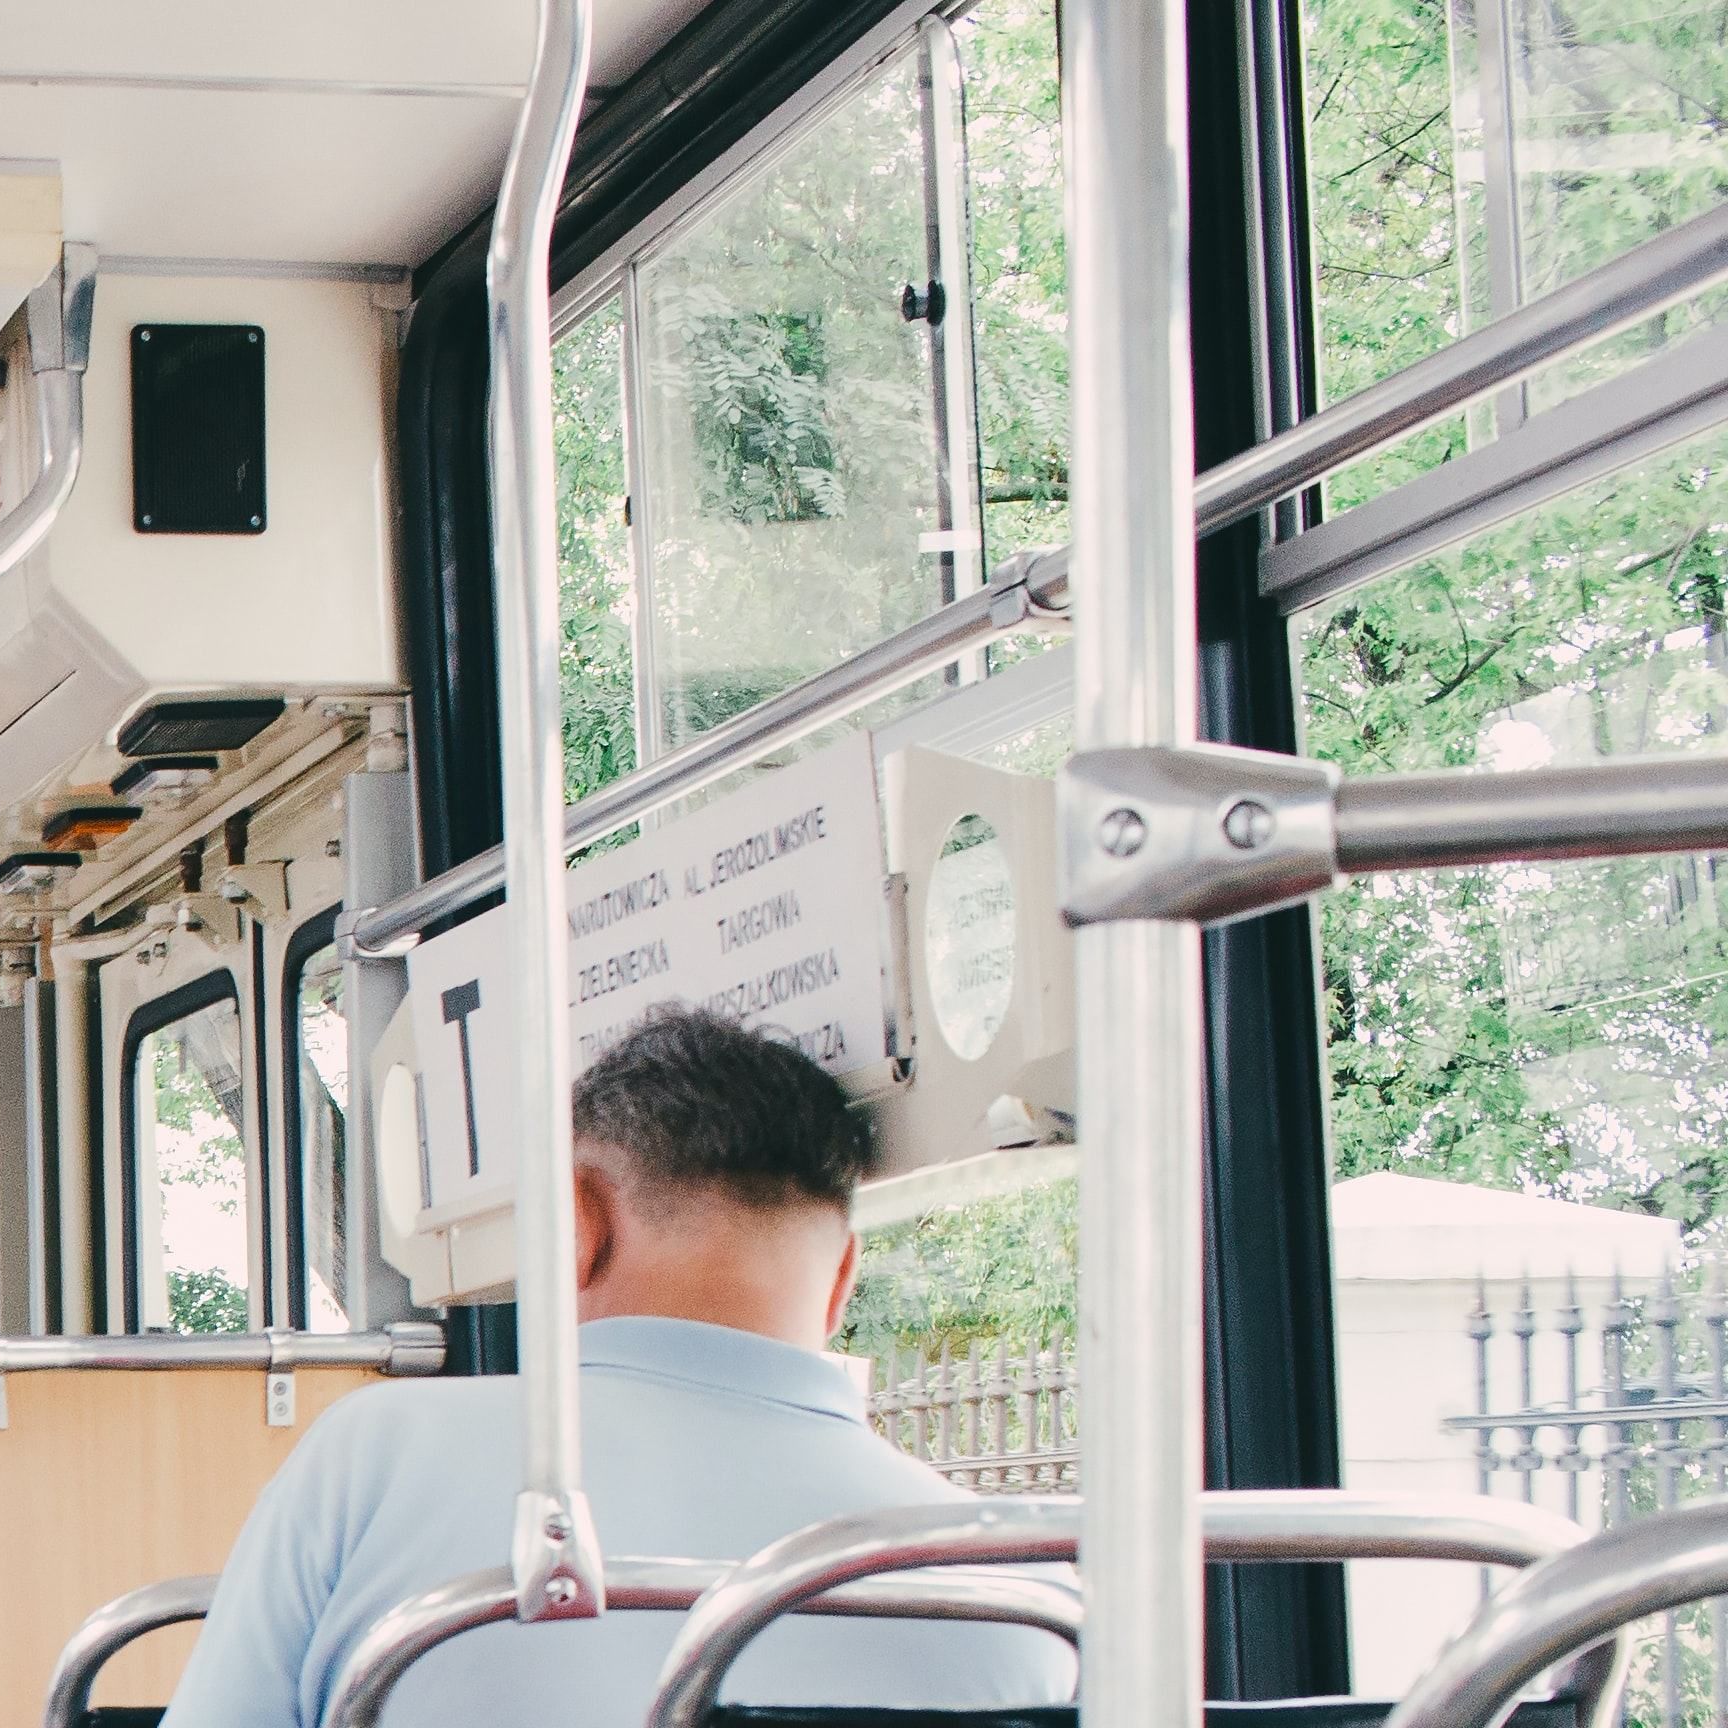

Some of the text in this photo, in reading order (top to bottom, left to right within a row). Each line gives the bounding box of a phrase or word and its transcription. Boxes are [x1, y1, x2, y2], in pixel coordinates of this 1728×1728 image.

[567, 867, 671, 941] NARUTOWICZA
[709, 804, 827, 889] JEROZOLIMSKIE
[578, 887, 801, 1002] ZIELENIECKA TARGOWA
[698, 947, 841, 1018] ARSZAŁKOWSKA
[440, 978, 482, 1174] T
